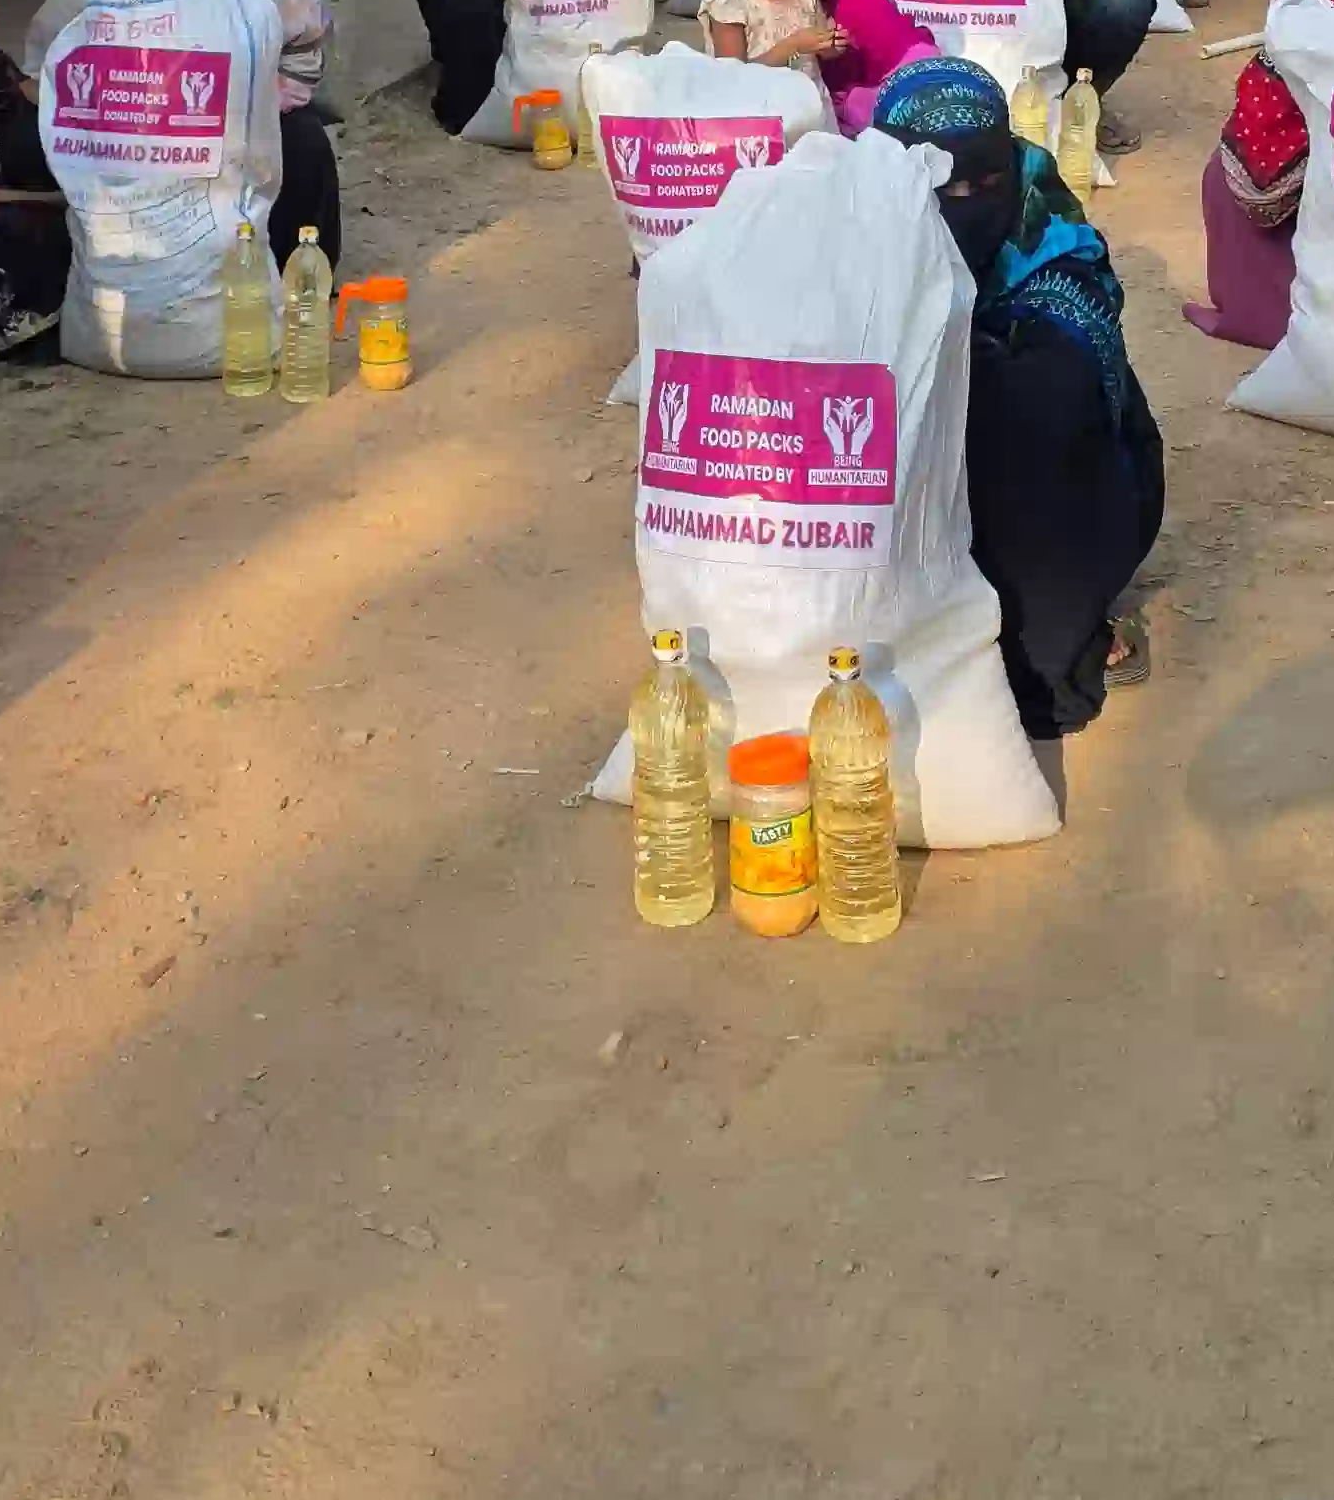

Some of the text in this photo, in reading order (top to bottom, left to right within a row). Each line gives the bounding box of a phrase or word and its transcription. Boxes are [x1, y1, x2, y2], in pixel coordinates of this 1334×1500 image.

[971, 12, 1018, 27] ZUBAIR
[102, 89, 130, 104] FOOD
[150, 146, 210, 165] ZUBAIR
[655, 143, 717, 157] RAMADAN
[651, 163, 725, 177] FOOD PACKS
[657, 184, 704, 197] DONATED
[705, 184, 719, 196] BY
[710, 394, 794, 420] RAMADAN
[699, 426, 804, 454] FOOD PACKS
[834, 455, 863, 468] BEING
[705, 459, 795, 484] DONATED BY
[810, 470, 887, 486] HUMANITARIAN
[644, 502, 876, 550] MUHAMMAD ZUBAIR
[754, 824, 790, 844] TASTY
